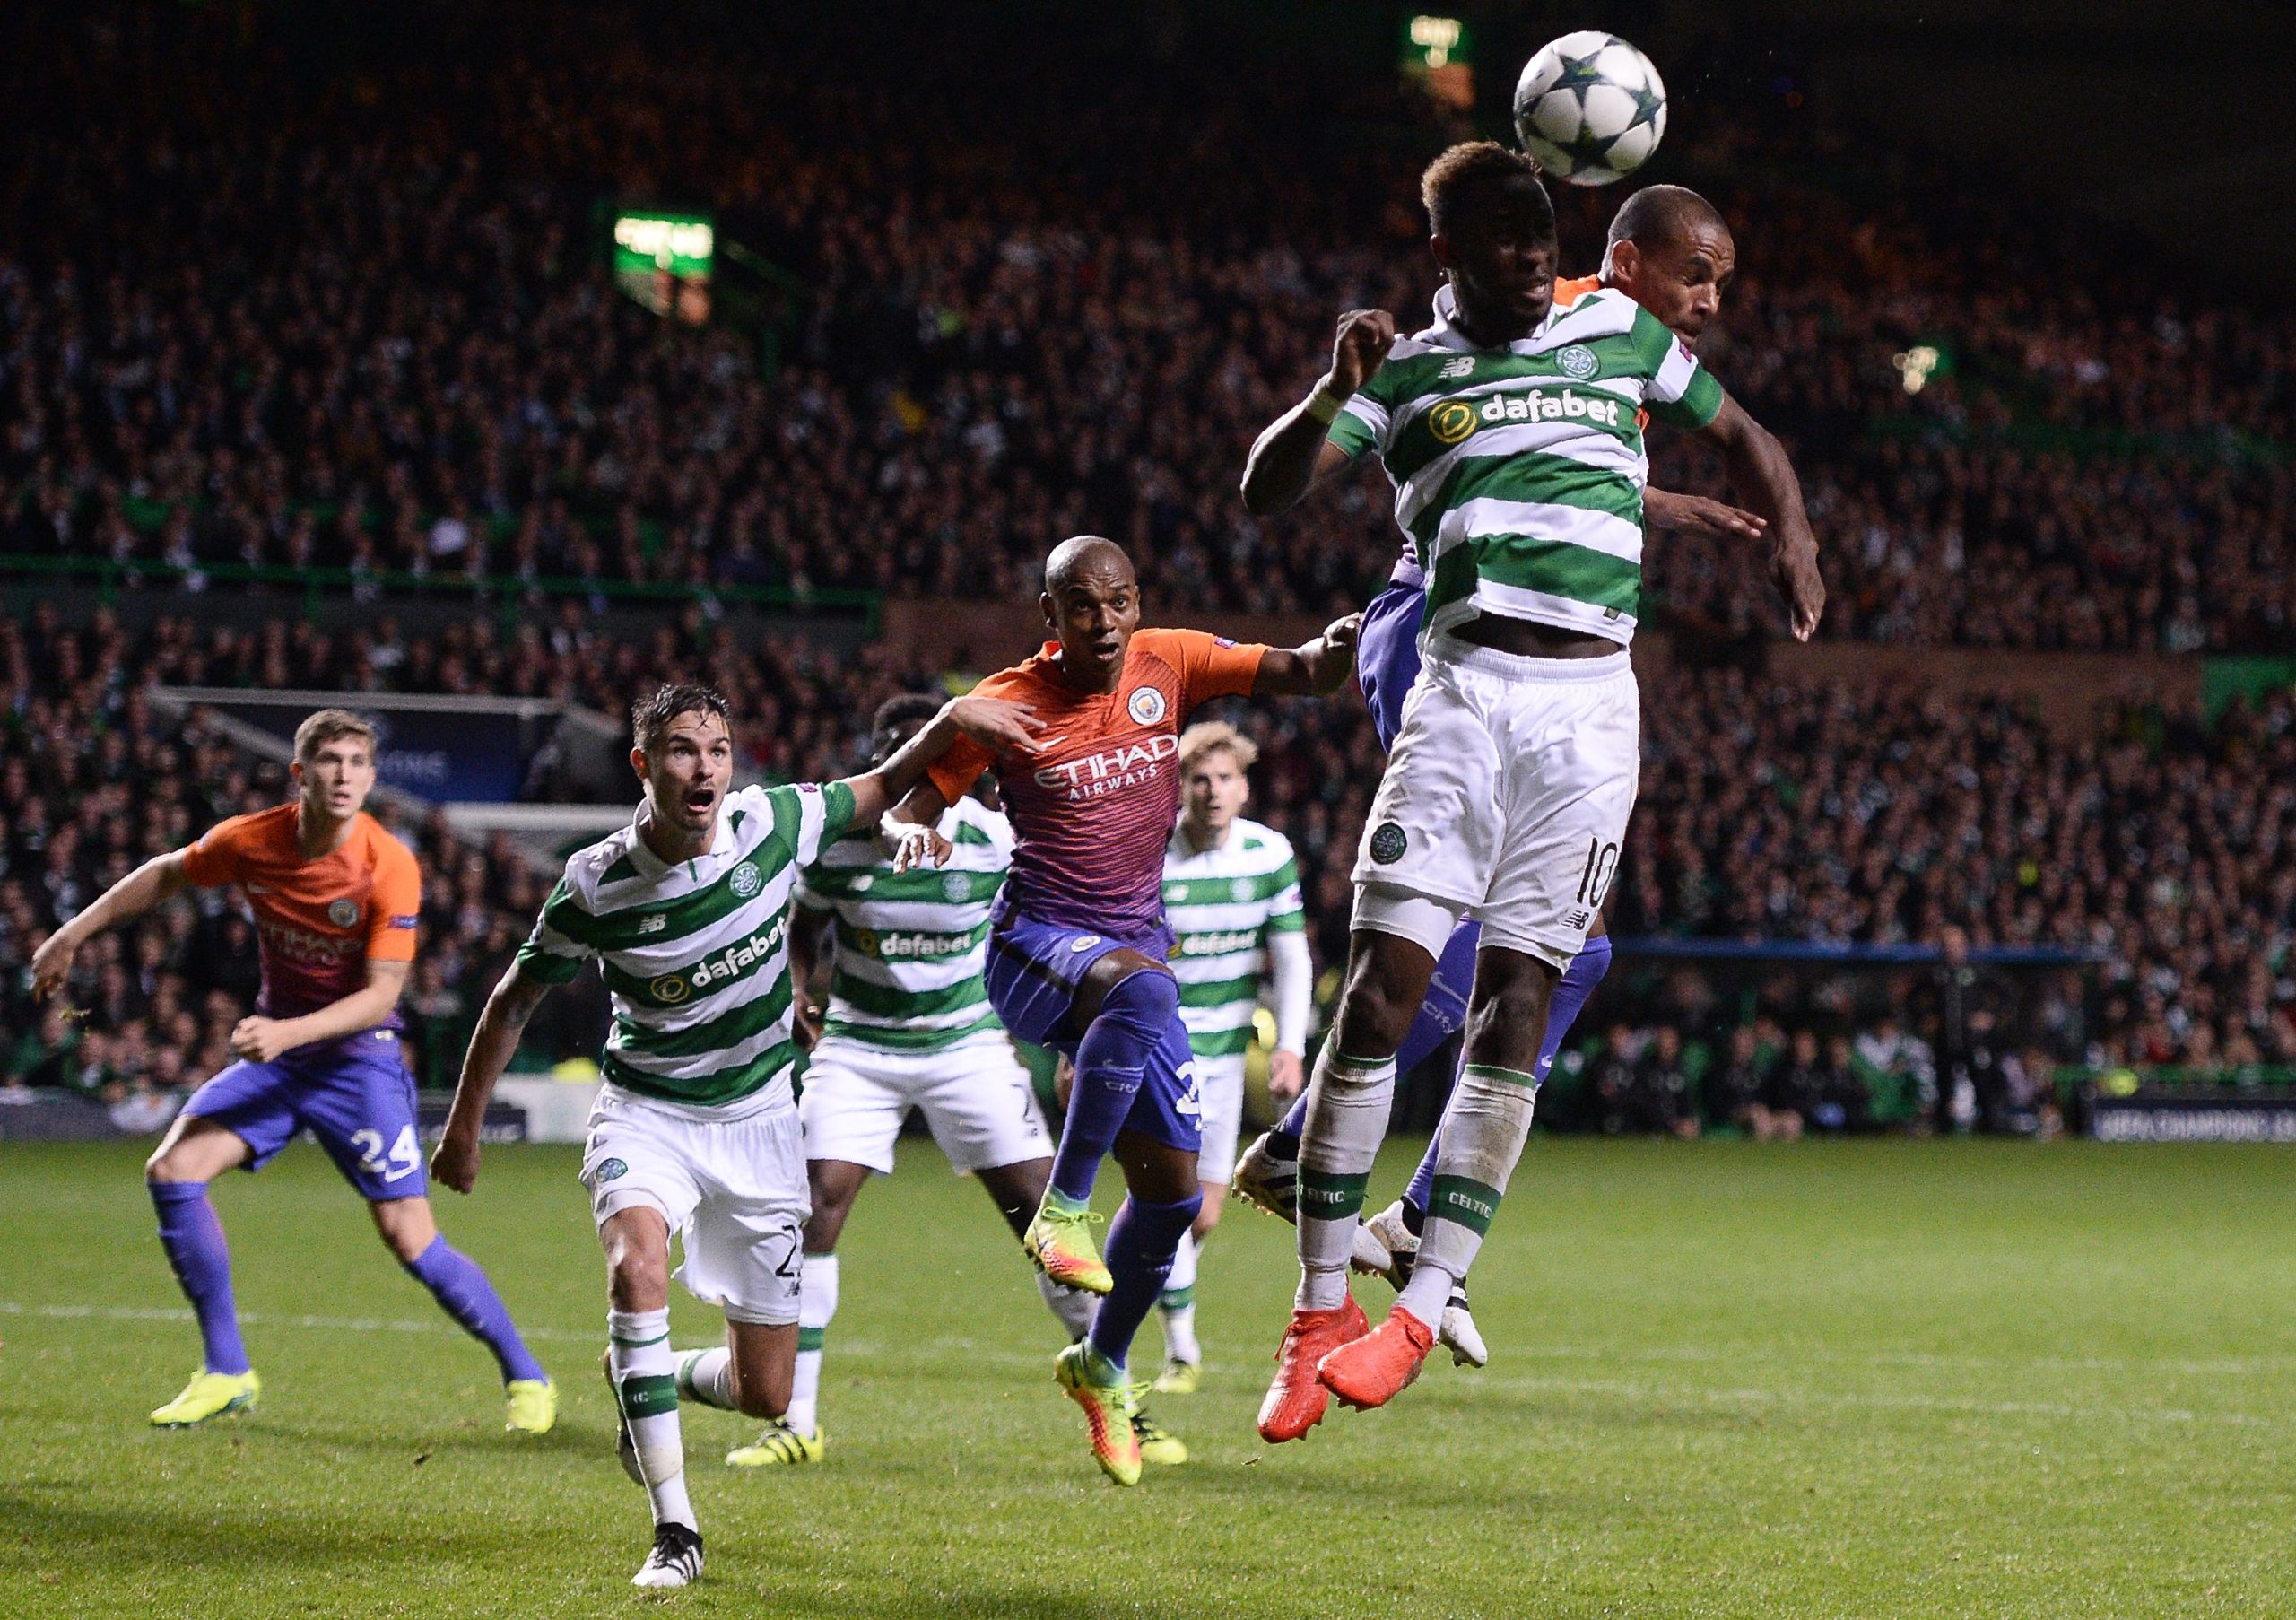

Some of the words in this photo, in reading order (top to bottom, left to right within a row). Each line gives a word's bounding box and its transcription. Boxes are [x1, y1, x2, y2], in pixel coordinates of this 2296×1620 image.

[1481, 389, 1618, 426] dafabet
[1034, 734, 1179, 788] ETIHAD
[1068, 762, 1158, 801] AIRWAYS
[1577, 837, 1617, 907] 10
[691, 916, 786, 988] dafabet
[880, 932, 972, 957] dafabet
[351, 1123, 422, 1183] 24
[1448, 1191, 1492, 1221] CELTIC
